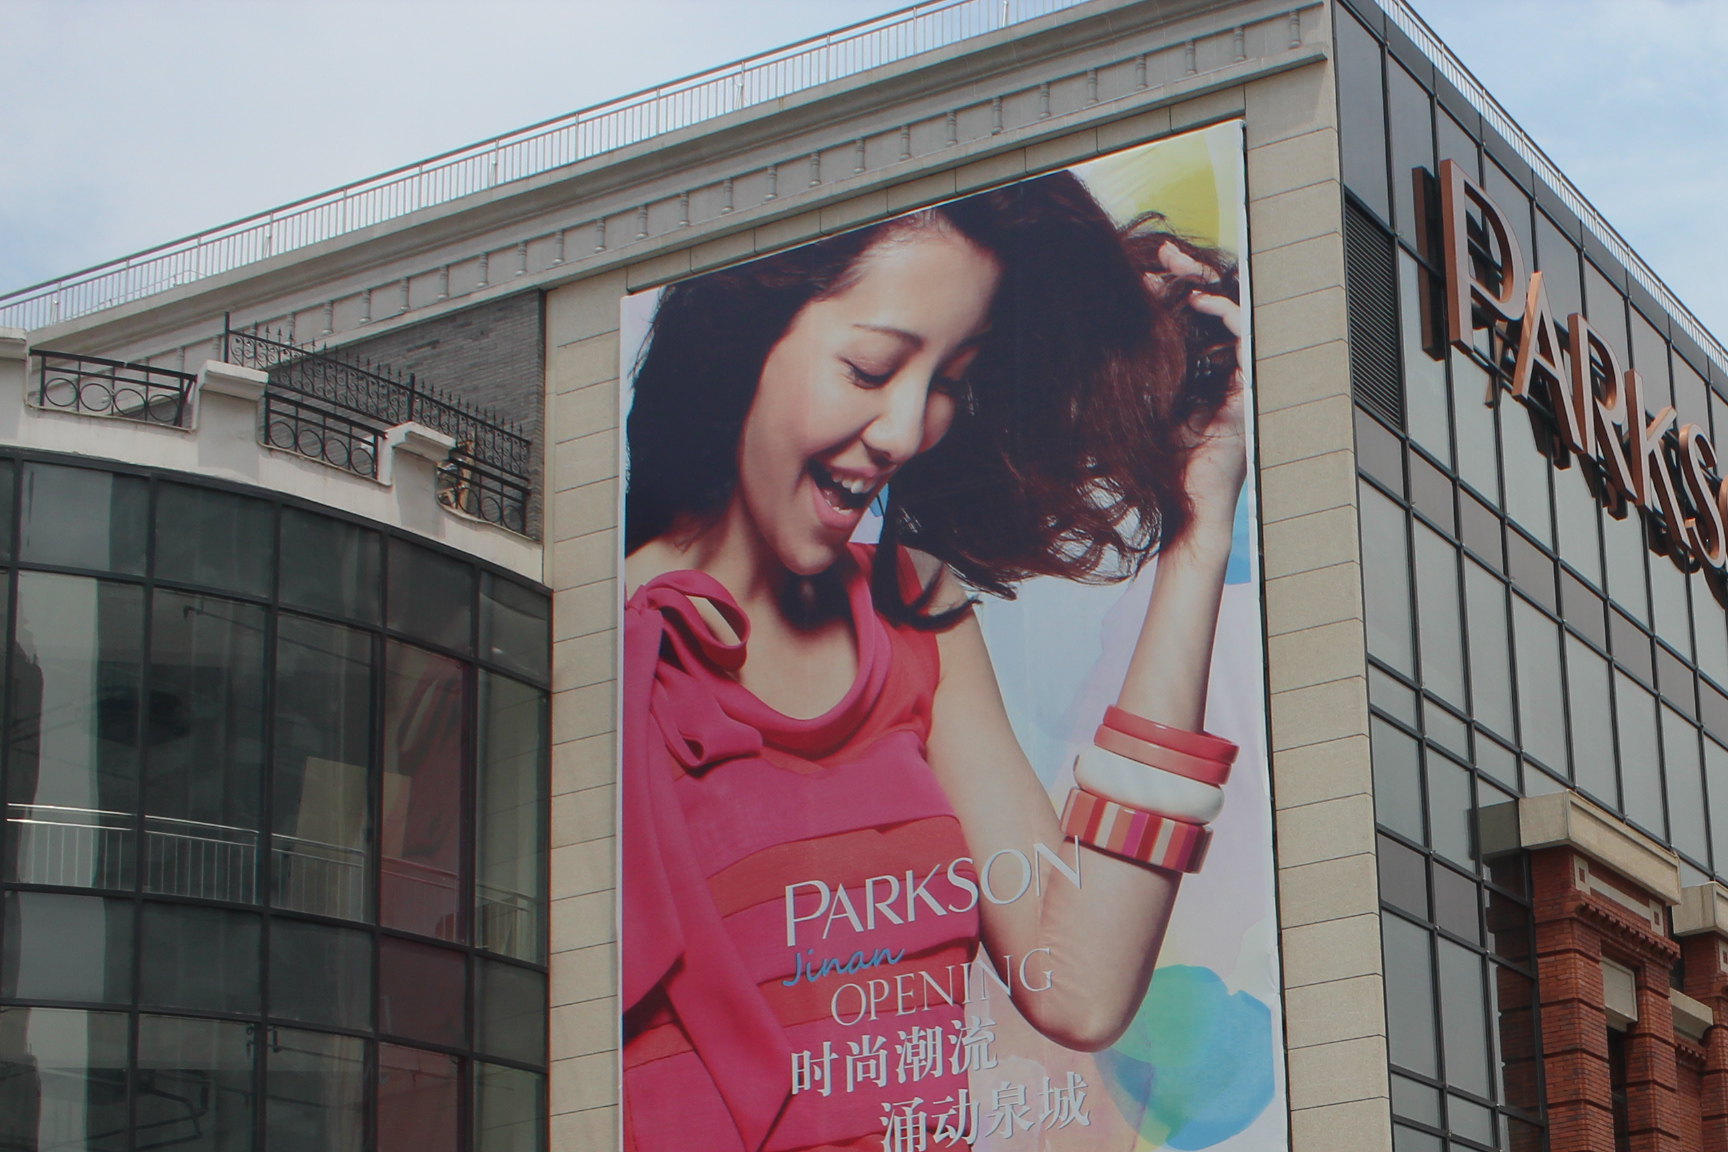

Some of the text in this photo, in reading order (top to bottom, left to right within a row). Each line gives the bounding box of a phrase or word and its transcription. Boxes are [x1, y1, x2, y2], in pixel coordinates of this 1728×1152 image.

[784, 835, 1083, 947] PARKSON
[781, 944, 905, 987] Jinan
[830, 946, 1055, 1026] OPENING
[790, 1015, 998, 1097] 时尚潮流
